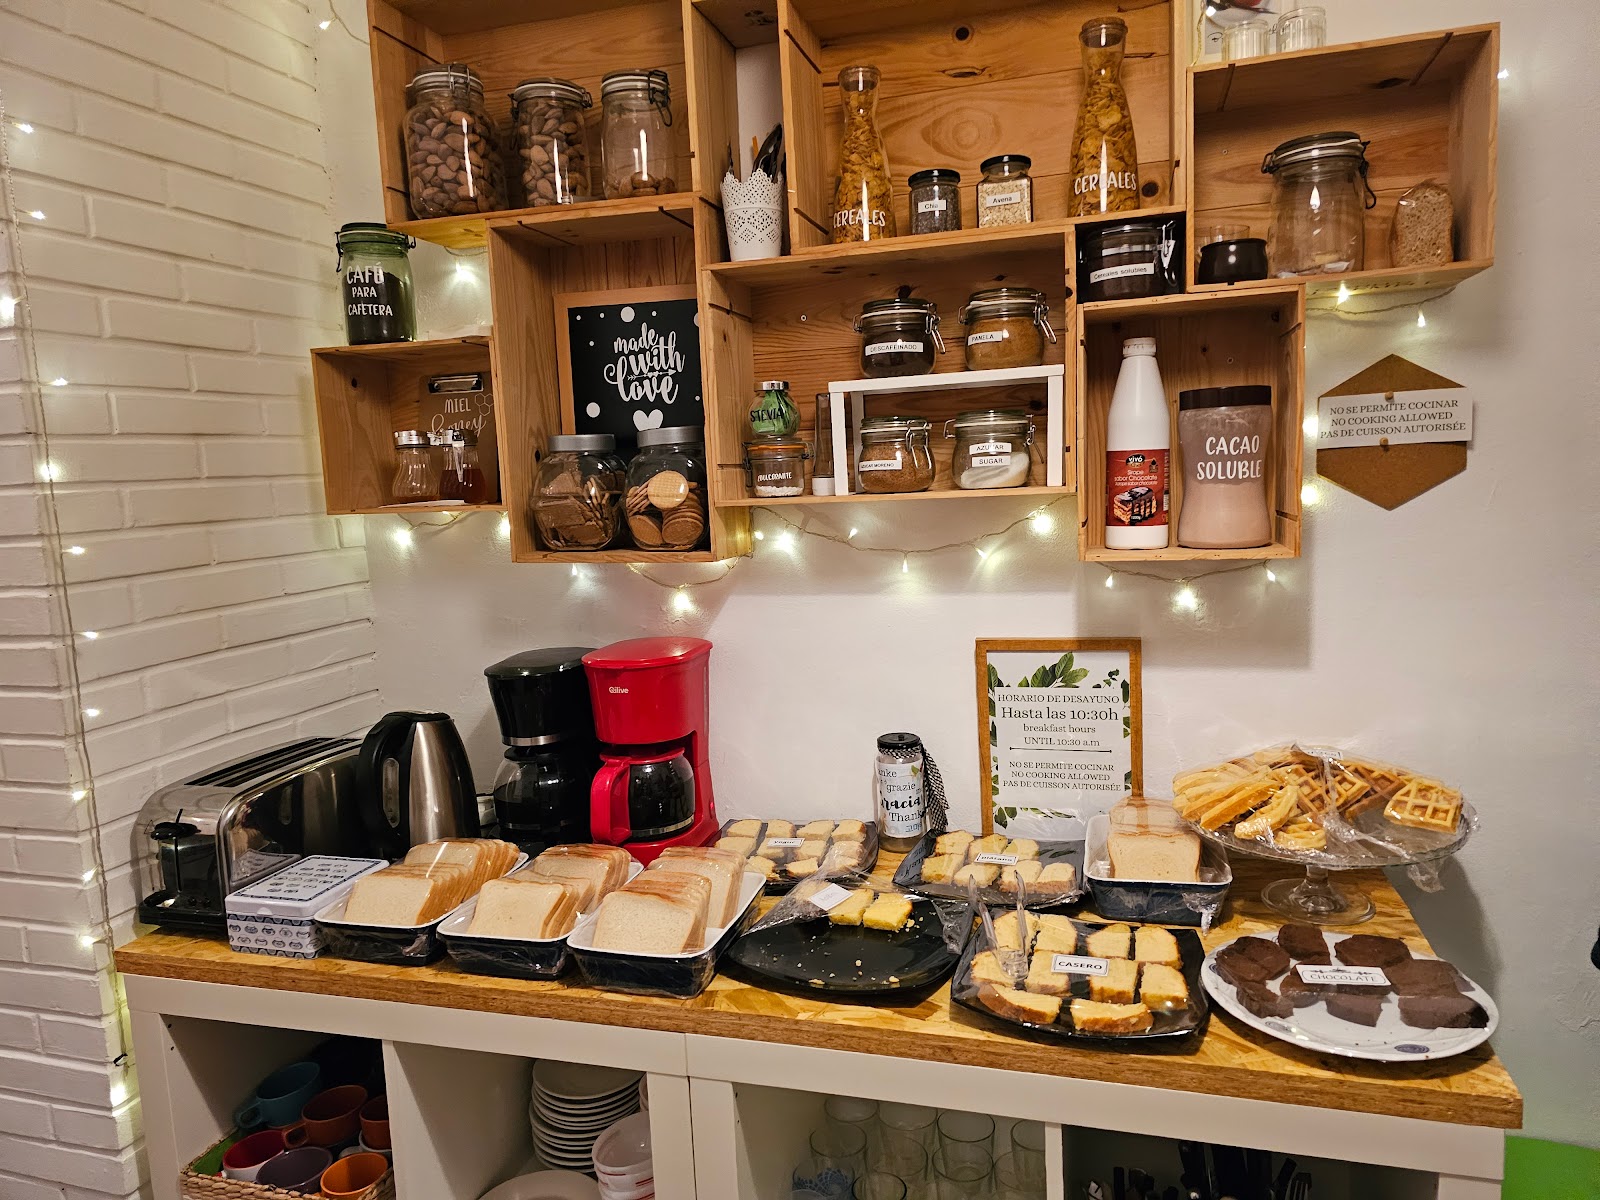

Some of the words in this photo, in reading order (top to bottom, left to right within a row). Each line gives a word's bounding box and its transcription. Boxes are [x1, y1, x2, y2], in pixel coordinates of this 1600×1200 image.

[992, 196, 1013, 204] Avena
[351, 286, 377, 298] PARA
[348, 302, 393, 316] CAFETERA
[613, 322, 659, 354] made
[971, 334, 995, 342] PANELA
[628, 331, 686, 376] with
[603, 355, 679, 405] love
[444, 397, 472, 413] MIEL
[1330, 406, 1345, 415] NO
[1346, 405, 1359, 415] SE
[1360, 402, 1407, 413] PERMITE
[1408, 400, 1459, 410] COCINAR
[750, 406, 785, 423] STEVIA
[1331, 418, 1346, 426] NO
[1348, 414, 1397, 425] COOKING
[1398, 411, 1453, 422] ALLOWED
[1320, 430, 1339, 438] PAS
[1340, 429, 1355, 437] DE
[1356, 426, 1402, 436] CUISSON
[1403, 421, 1466, 433] AUTORISÉE
[1205, 434, 1260, 456] CACAO
[1196, 459, 1263, 480] SOLUBLE
[998, 694, 1045, 703] HORARIO
[1046, 694, 1061, 703] DE
[1063, 695, 1120, 704] DESAYUNO
[1001, 706, 1043, 719] Hasta
[1046, 706, 1067, 720] las
[1070, 707, 1119, 721] 10:30h
[1023, 723, 1067, 733] breakfast
[1068, 724, 1096, 734] hours
[1024, 737, 1056, 745] UNTIL
[1057, 738, 1081, 746] 10:30
[1009, 761, 1022, 769] NO
[1023, 761, 1034, 769] SE
[1035, 762, 1074, 770] PERMITE
[1074, 763, 1115, 772] COCINAR
[1025, 771, 1066, 780] COOKING
[1067, 773, 1111, 781] ALLOWED
[886, 783, 916, 793] grazie
[1032, 781, 1071, 790] CUISSON
[1071, 782, 1122, 791] AUTORISÉE
[1058, 961, 1103, 970] CASERO
[1310, 973, 1378, 982] CHOCOLATE
